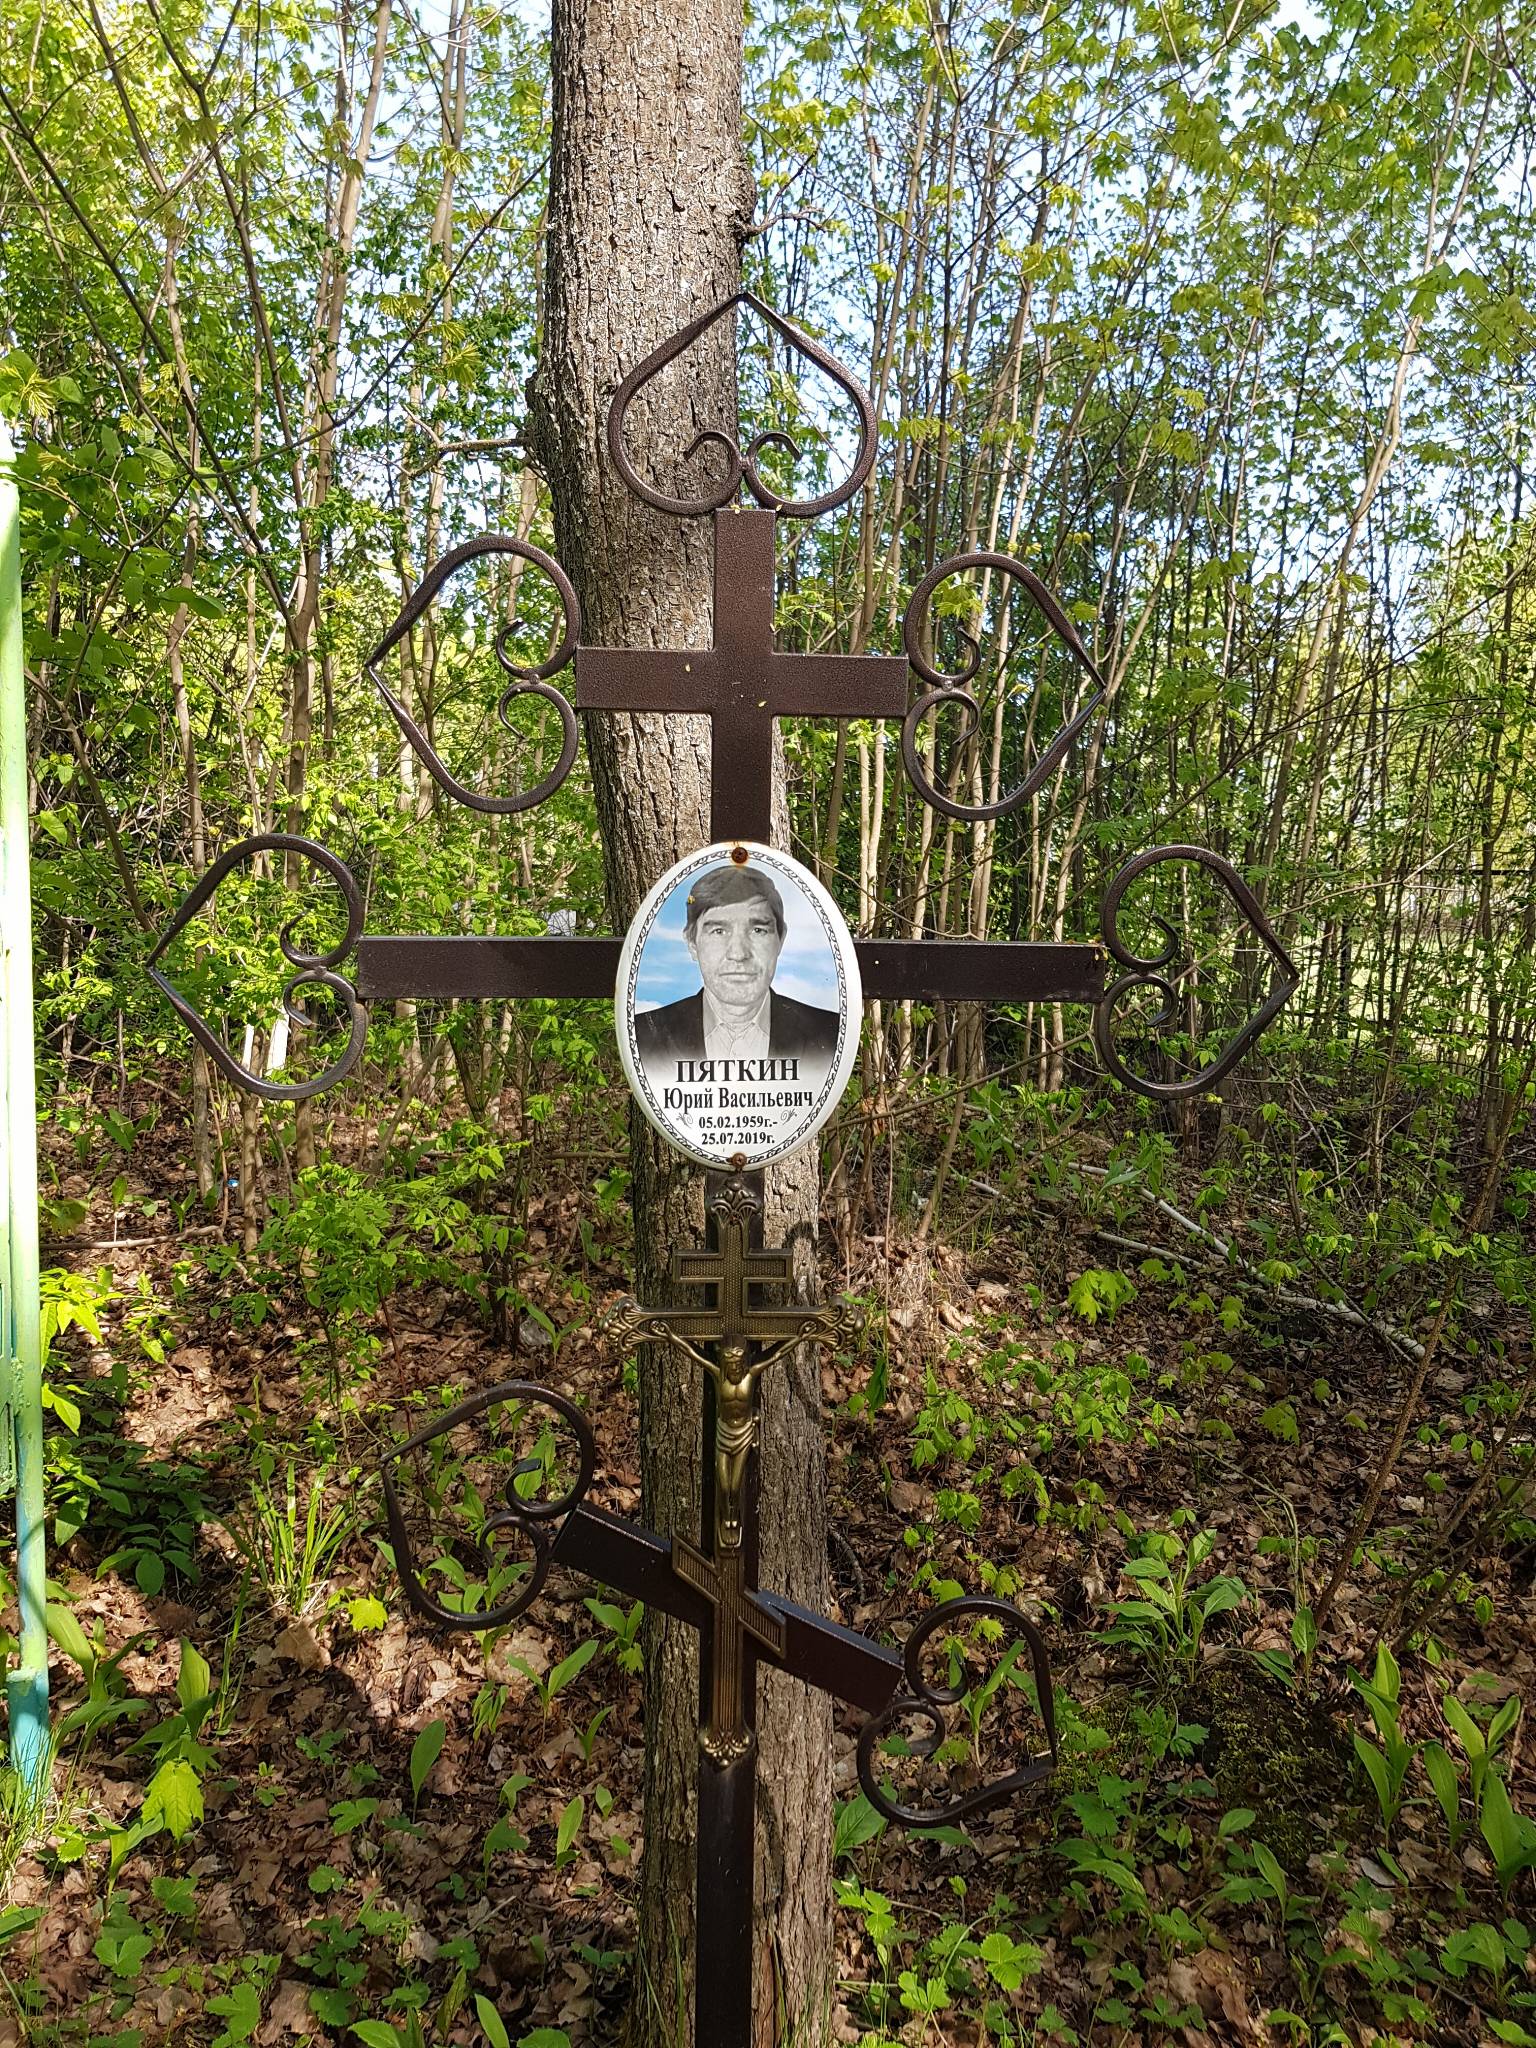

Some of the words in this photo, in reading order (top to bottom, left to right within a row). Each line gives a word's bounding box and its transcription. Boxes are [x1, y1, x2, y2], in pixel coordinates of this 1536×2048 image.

[675, 1058, 800, 1083] ПЯТКИН
[663, 1087, 713, 1114] Юрий
[718, 1087, 813, 1109] Васильевич
[701, 1132, 775, 1145] 25.07.2019г.
